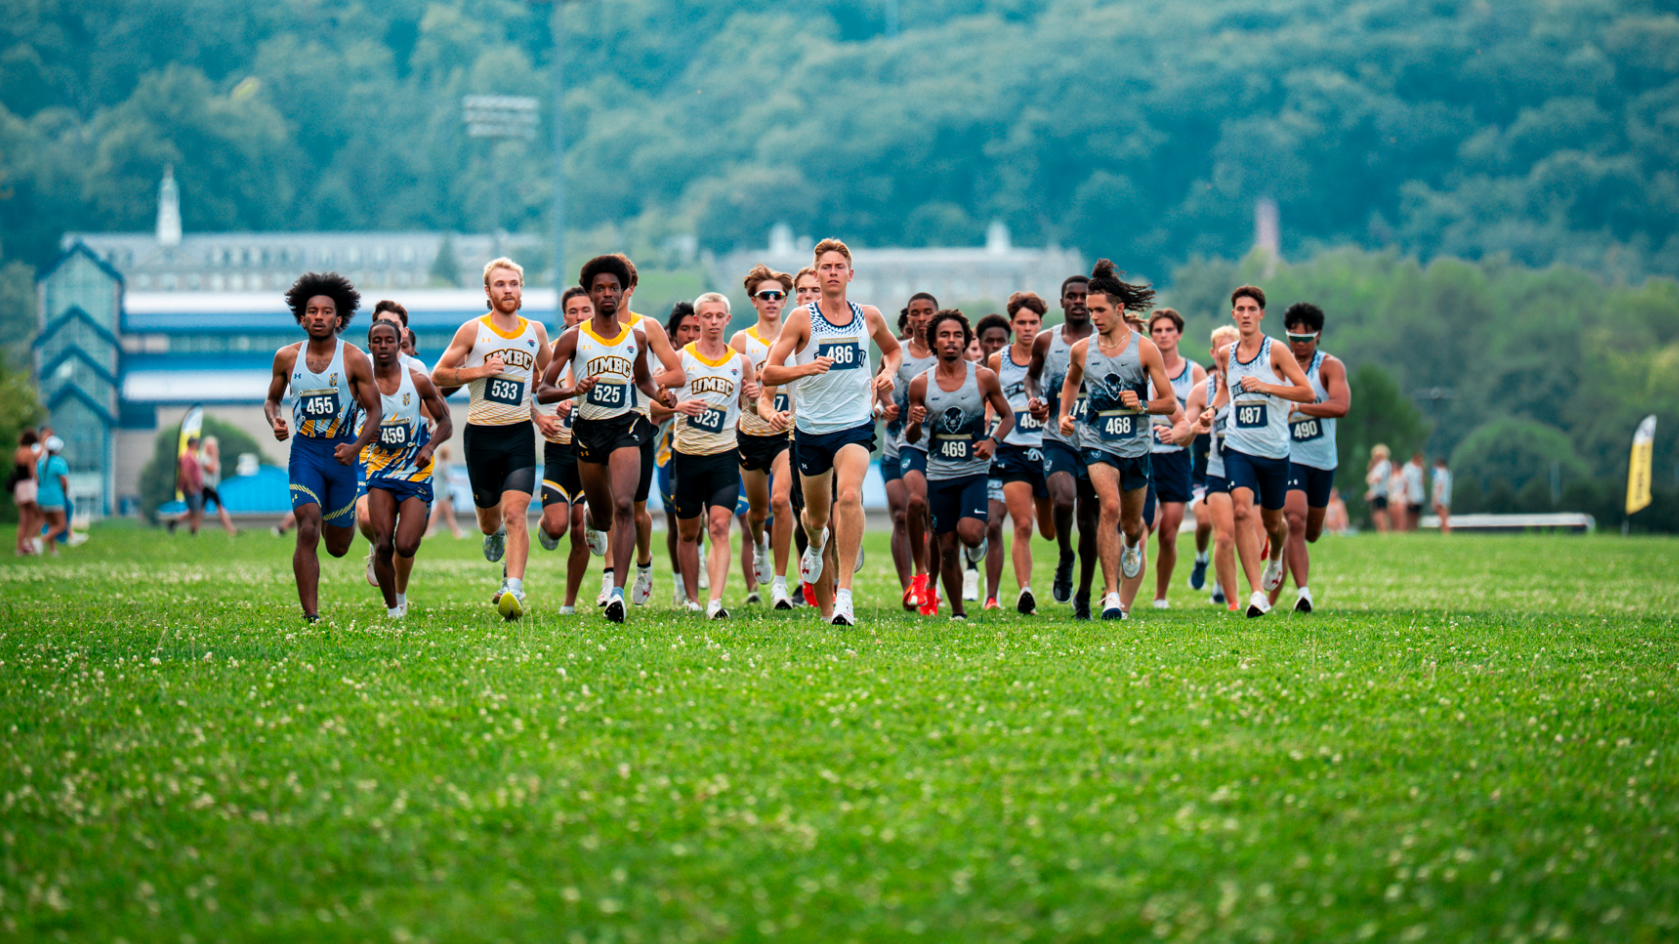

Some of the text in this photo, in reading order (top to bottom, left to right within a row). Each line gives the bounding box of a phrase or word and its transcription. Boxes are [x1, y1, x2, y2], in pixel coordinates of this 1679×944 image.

[826, 345, 853, 364] 486
[587, 355, 631, 378] UMBC
[491, 380, 518, 400] 533
[594, 384, 620, 403] 525
[691, 376, 734, 397] UMBC
[306, 396, 333, 415] 455
[1240, 407, 1261, 424] 487
[381, 426, 405, 444] 459
[1105, 417, 1131, 435] 468
[1294, 420, 1318, 439] 490
[941, 441, 966, 457] 469
